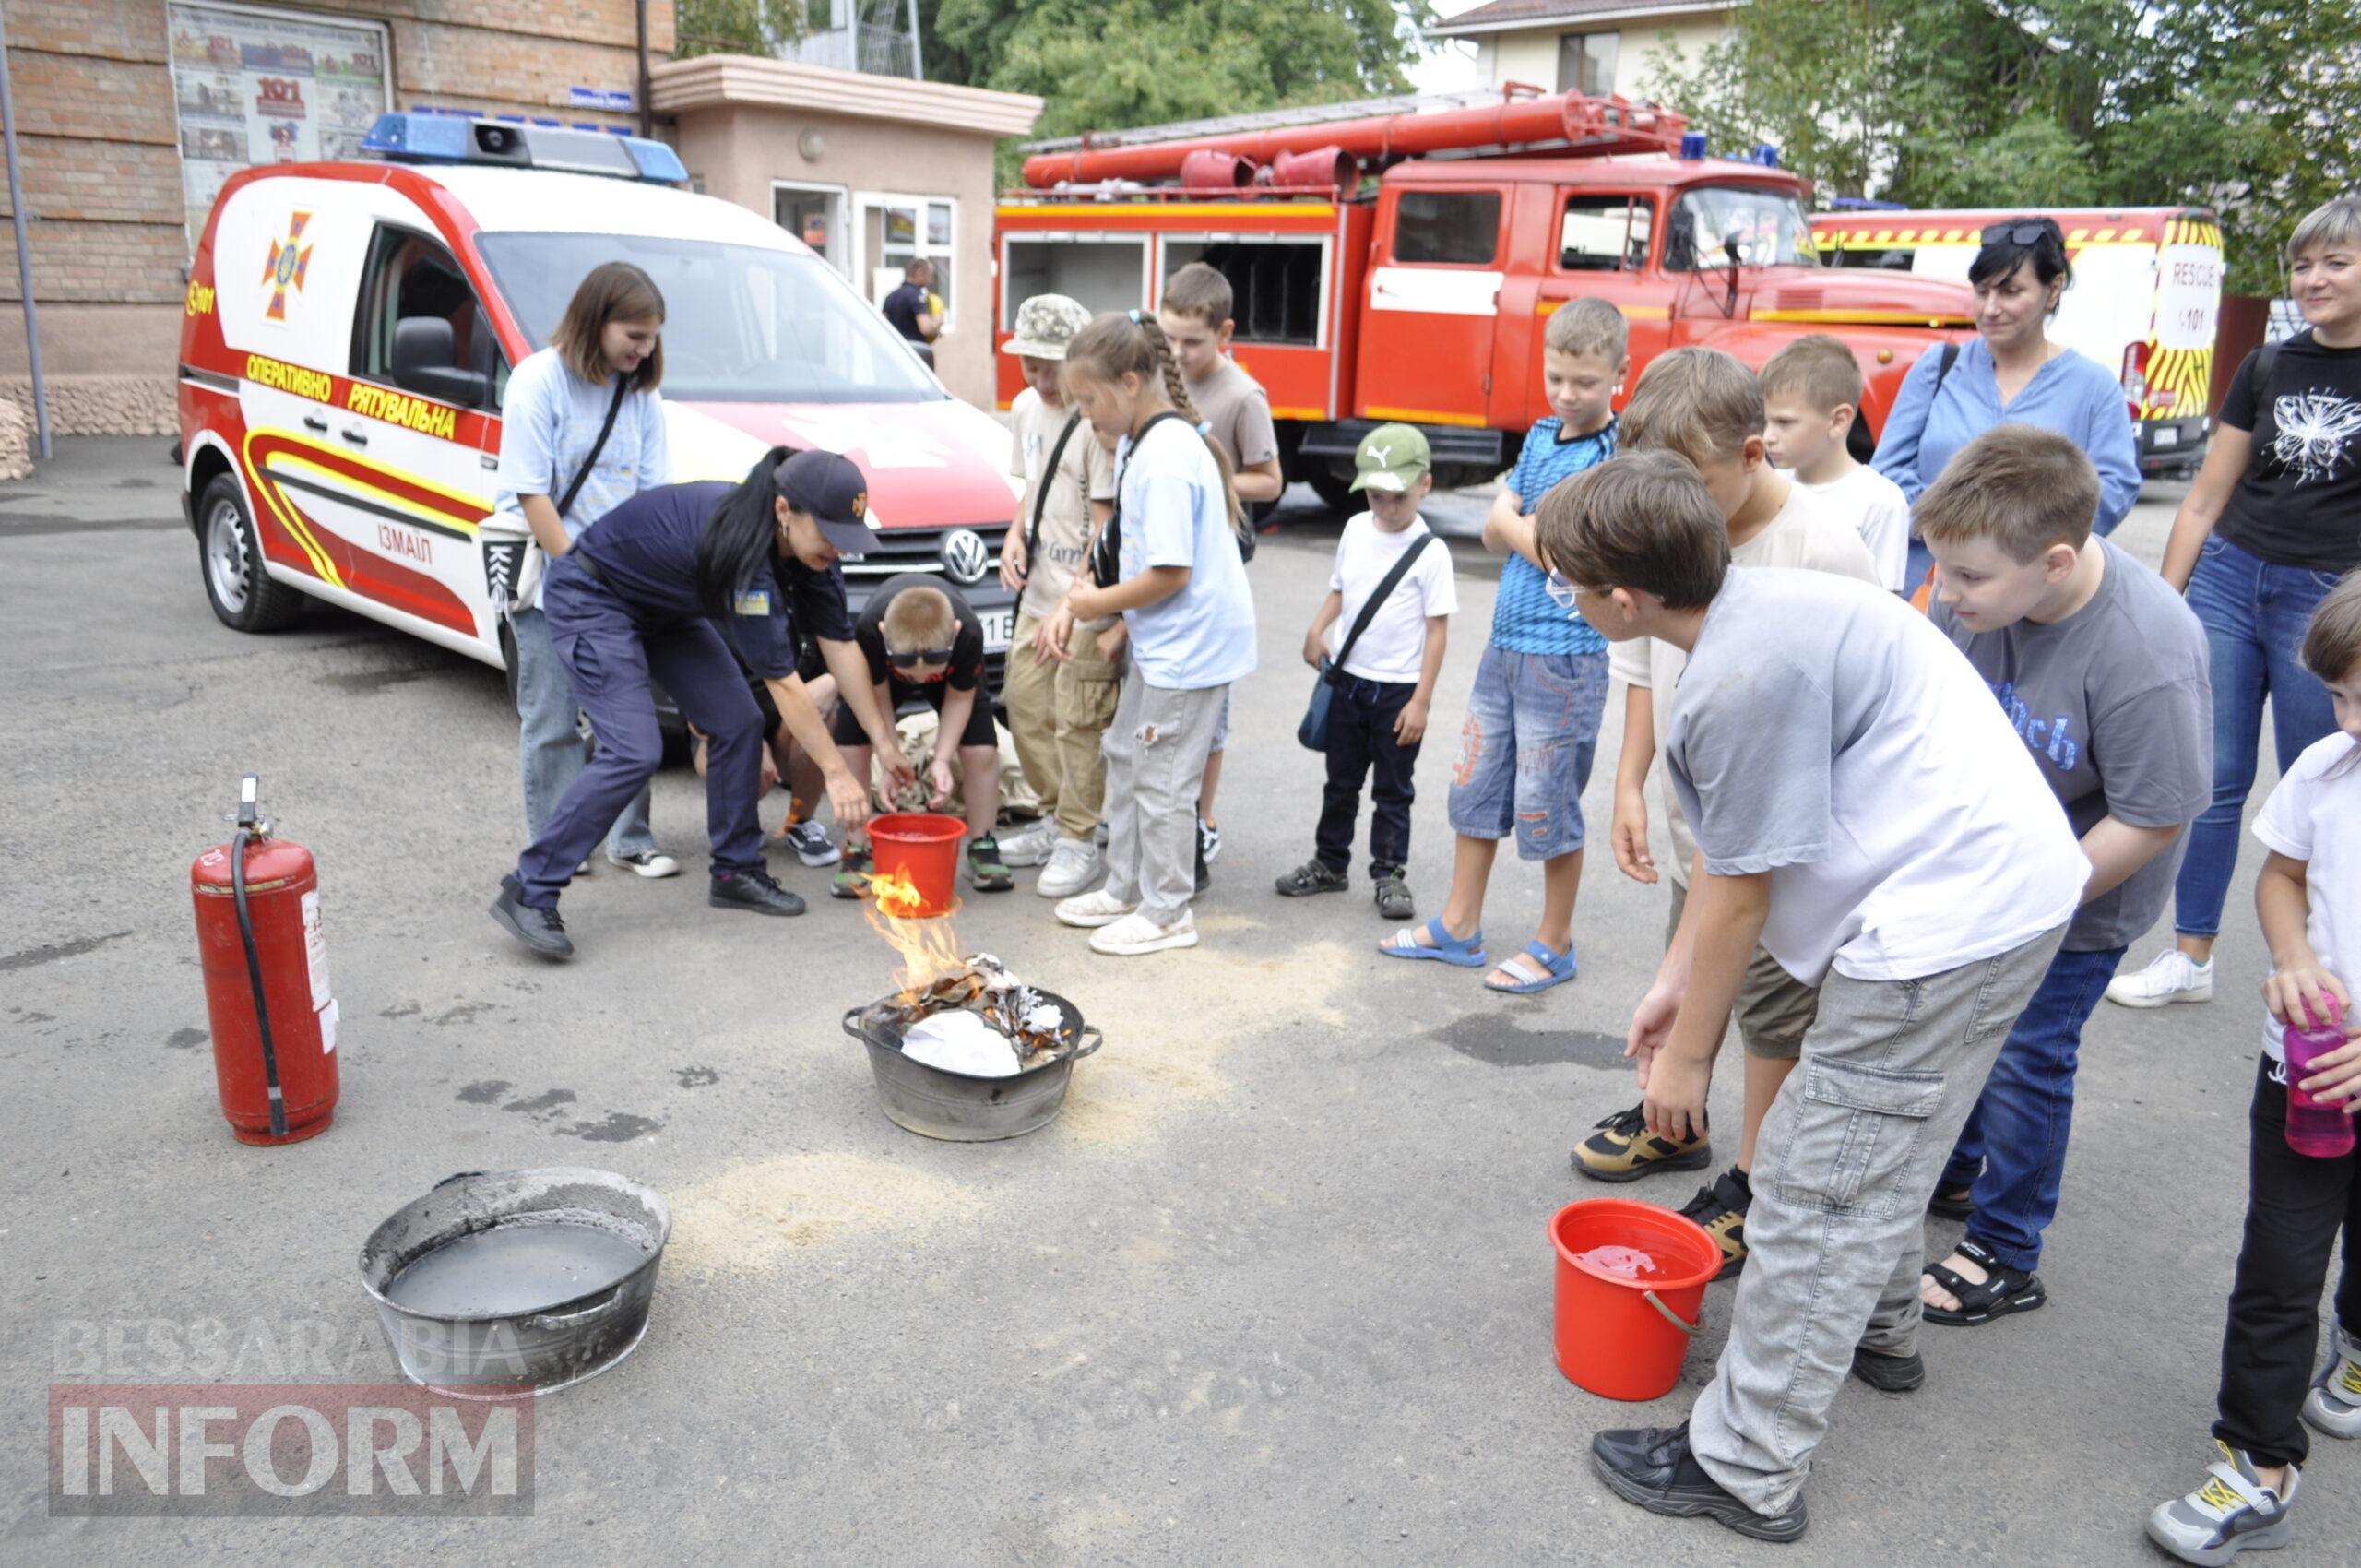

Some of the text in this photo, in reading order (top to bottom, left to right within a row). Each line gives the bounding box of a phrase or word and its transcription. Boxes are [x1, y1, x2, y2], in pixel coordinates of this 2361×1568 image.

[257, 77, 302, 103] 101
[2174, 262, 2214, 287] RESCUE
[198, 287, 215, 314] 101
[2188, 308, 2204, 330] 101
[246, 354, 456, 441] ОПЕРАТИВНО РЯТУВАЛЬНА
[378, 523, 433, 565] ІЗМАЇЛ
